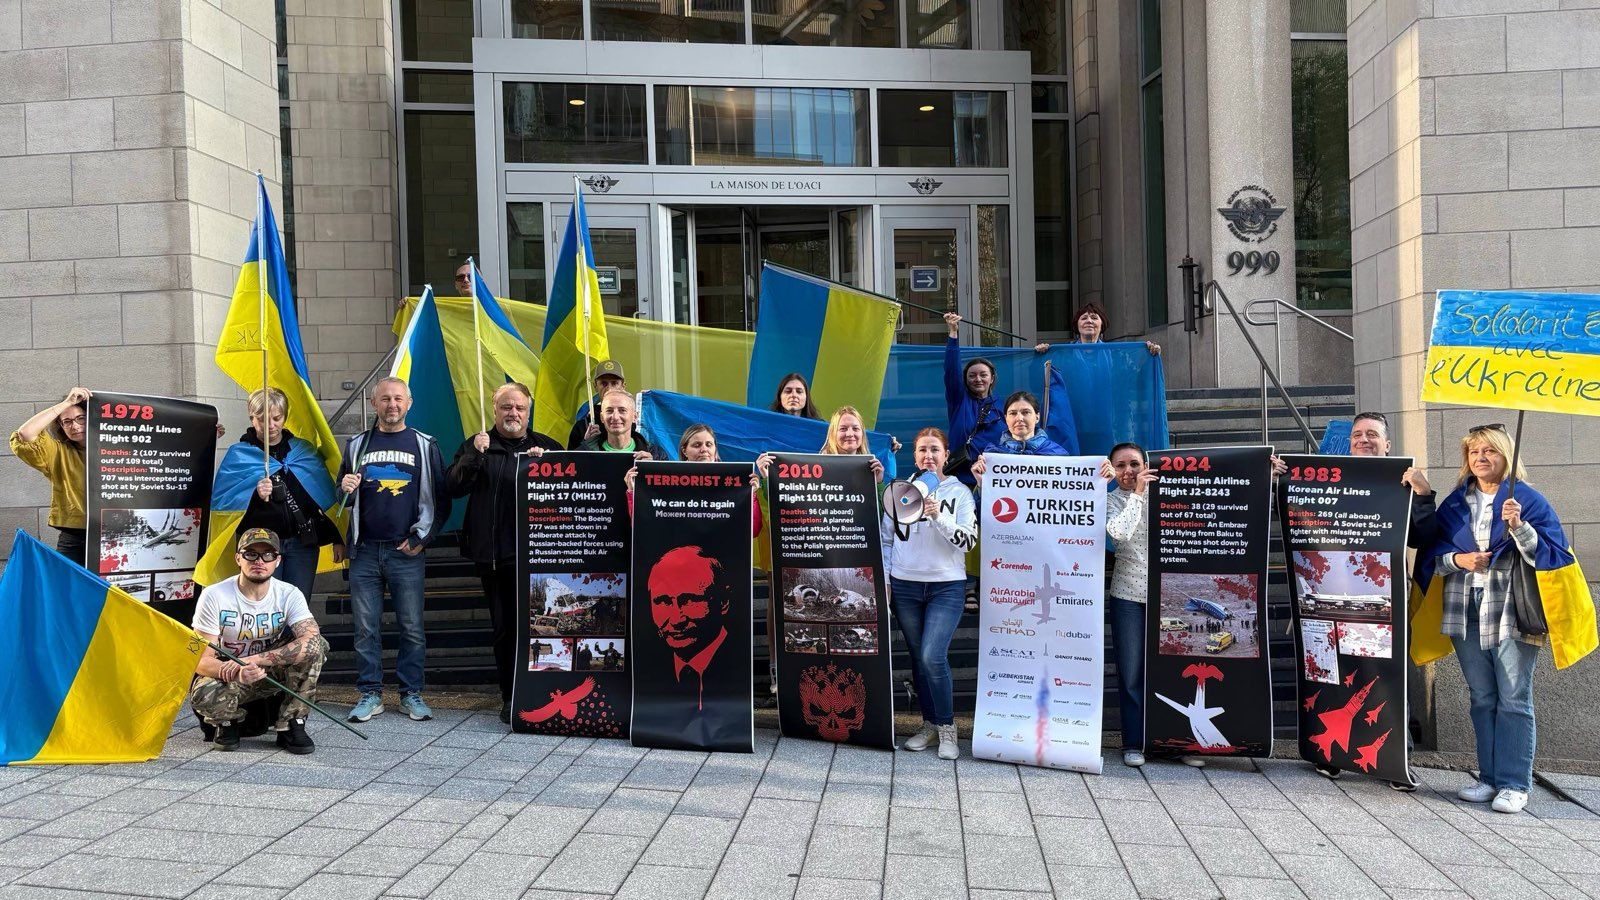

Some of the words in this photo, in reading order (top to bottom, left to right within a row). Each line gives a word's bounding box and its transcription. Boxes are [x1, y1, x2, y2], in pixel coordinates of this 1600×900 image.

[711, 180, 724, 189] LA
[728, 180, 768, 189] MAISON
[772, 181, 785, 189] DE
[788, 181, 821, 190] L'OACI
[1228, 250, 1280, 277] 999
[1493, 340, 1563, 360] avec
[101, 403, 154, 420] 1978
[100, 422, 136, 432] Korean
[138, 424, 154, 432] Air
[156, 425, 181, 433] Lines
[100, 434, 129, 444] Flight
[362, 450, 416, 467] UKRAINE
[1160, 456, 1211, 472] 2024
[528, 462, 577, 477] 2014
[778, 464, 823, 478] 2010
[992, 465, 1061, 475] COMPANIES
[1065, 466, 1095, 477] THAT
[1291, 467, 1342, 483] 1983
[645, 474, 721, 487] TERRORIST
[724, 476, 742, 487] #1
[992, 479, 1012, 488] FLY
[1016, 480, 1048, 489] OVER
[1052, 480, 1095, 490] RUSSIA
[1159, 476, 1211, 486] Azerbaijan
[1214, 477, 1250, 486] Airlines
[528, 482, 569, 491] Malaysia
[1288, 485, 1323, 494] Korean
[1343, 488, 1371, 496] Lines
[528, 492, 555, 502] Flight
[571, 492, 606, 501] (MH17)
[1159, 488, 1187, 497] Flight
[1189, 488, 1230, 496] J2-8243
[780, 494, 805, 503] Flight
[825, 494, 844, 503] (PLF
[846, 494, 865, 503] 101)
[1287, 496, 1315, 506] Flight
[652, 499, 667, 507] We
[710, 500, 735, 510] again
[1027, 499, 1094, 512] TURKISH
[1025, 512, 1095, 526] AIRLINES
[1321, 537, 1346, 545] Boeing
[990, 588, 1035, 598] AirArabia
[1056, 597, 1093, 606] Emirates
[220, 610, 285, 640] FREE
[990, 627, 1036, 636] ETIHAD
[1056, 630, 1092, 639] flydubai
